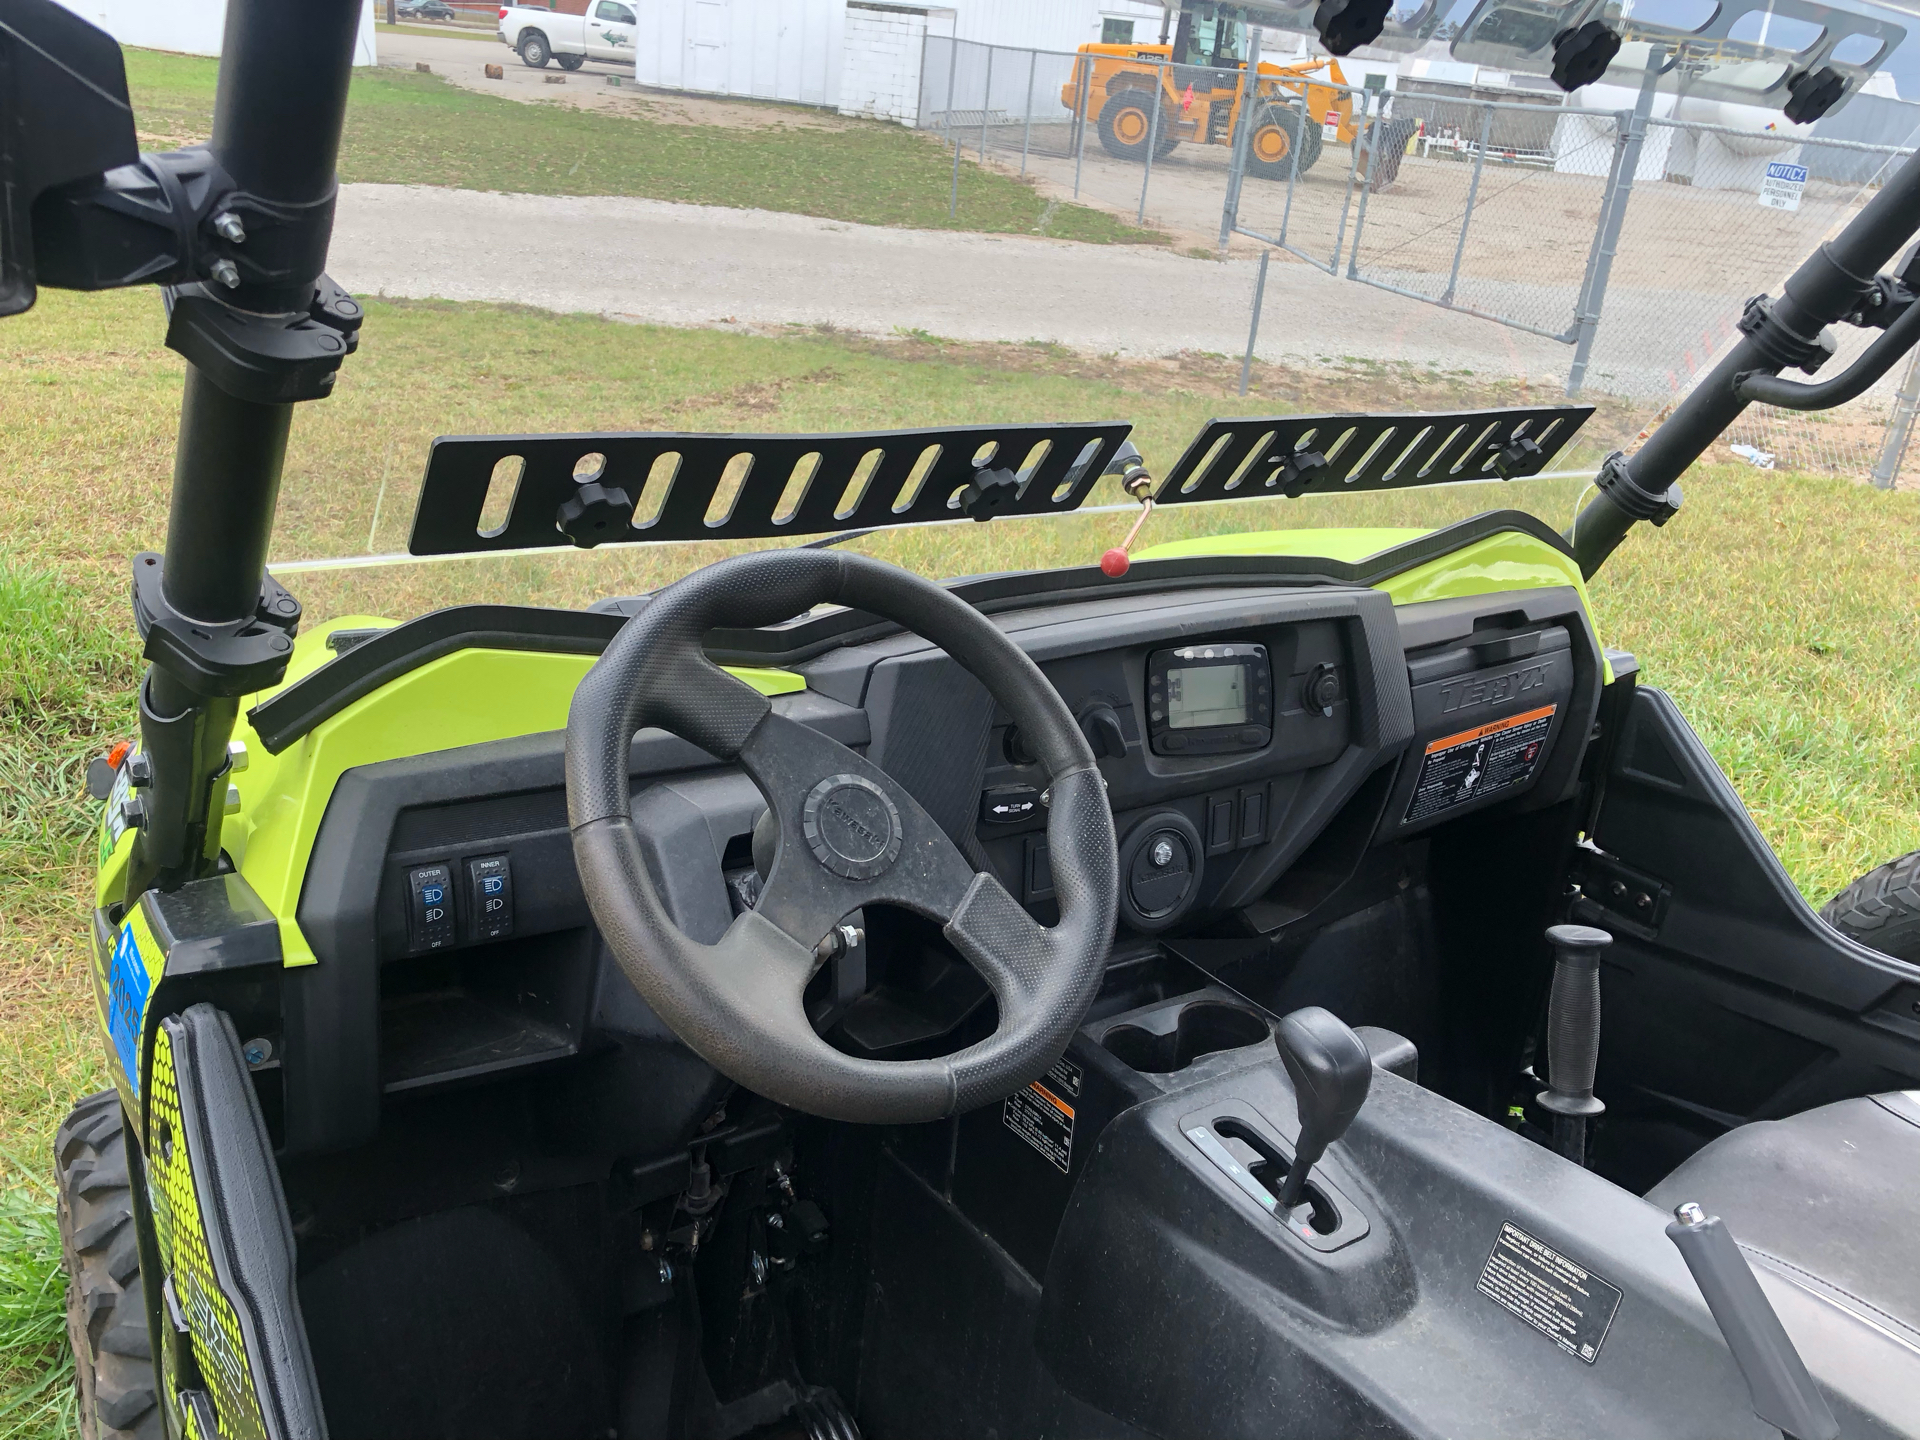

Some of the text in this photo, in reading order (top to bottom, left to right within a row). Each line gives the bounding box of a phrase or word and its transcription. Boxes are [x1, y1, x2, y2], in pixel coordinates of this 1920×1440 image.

[1767, 164, 1807, 181] NOTICE
[1763, 187, 1799, 200] PERSONNEL
[1765, 179, 1804, 192] AUTHORIZED
[1771, 198, 1787, 208] ONLY
[1441, 660, 1554, 714] TERYX
[1484, 720, 1510, 734] WARNING
[826, 797, 886, 850] Kawasaki
[418, 869, 441, 878] OUTER
[480, 860, 500, 868] INNER
[431, 940, 442, 948] OFF
[490, 929, 500, 937] OFF
[112, 963, 139, 1046] 2025
[1503, 1224, 1588, 1280] IMPORTANT DRIVE BELT INFORMATION
[1497, 1252, 1516, 1267] Inspection
[1549, 1285, 1560, 1294] drive
[1559, 1291, 1568, 1300] belt
[1498, 1267, 1508, 1276] drive
[1516, 1279, 1526, 1288] wear
[1525, 1285, 1535, 1293] with
[1534, 1290, 1547, 1301] normal
[1518, 1273, 1529, 1283] every
[1536, 1284, 1547, 1294] hours
[1544, 1266, 1553, 1274] belt
[1552, 1271, 1568, 1284] damage
[1568, 1281, 1577, 1289] and
[1486, 1266, 1496, 1275] More
[1510, 1282, 1530, 1297] inspection
[1561, 1315, 1576, 1327] vehicle
[1506, 1294, 1514, 1302] ride
[1520, 1303, 1533, 1314] vehicle
[1541, 1317, 1559, 1333] damaged
[1508, 1288, 1518, 1297] hard
[1551, 1316, 1560, 1325] belt
[1558, 1321, 1576, 1336] slippage
[1522, 1311, 1533, 1321] Refer
[1537, 1321, 1546, 1330] your
[1546, 1326, 1562, 1340] Owner's
